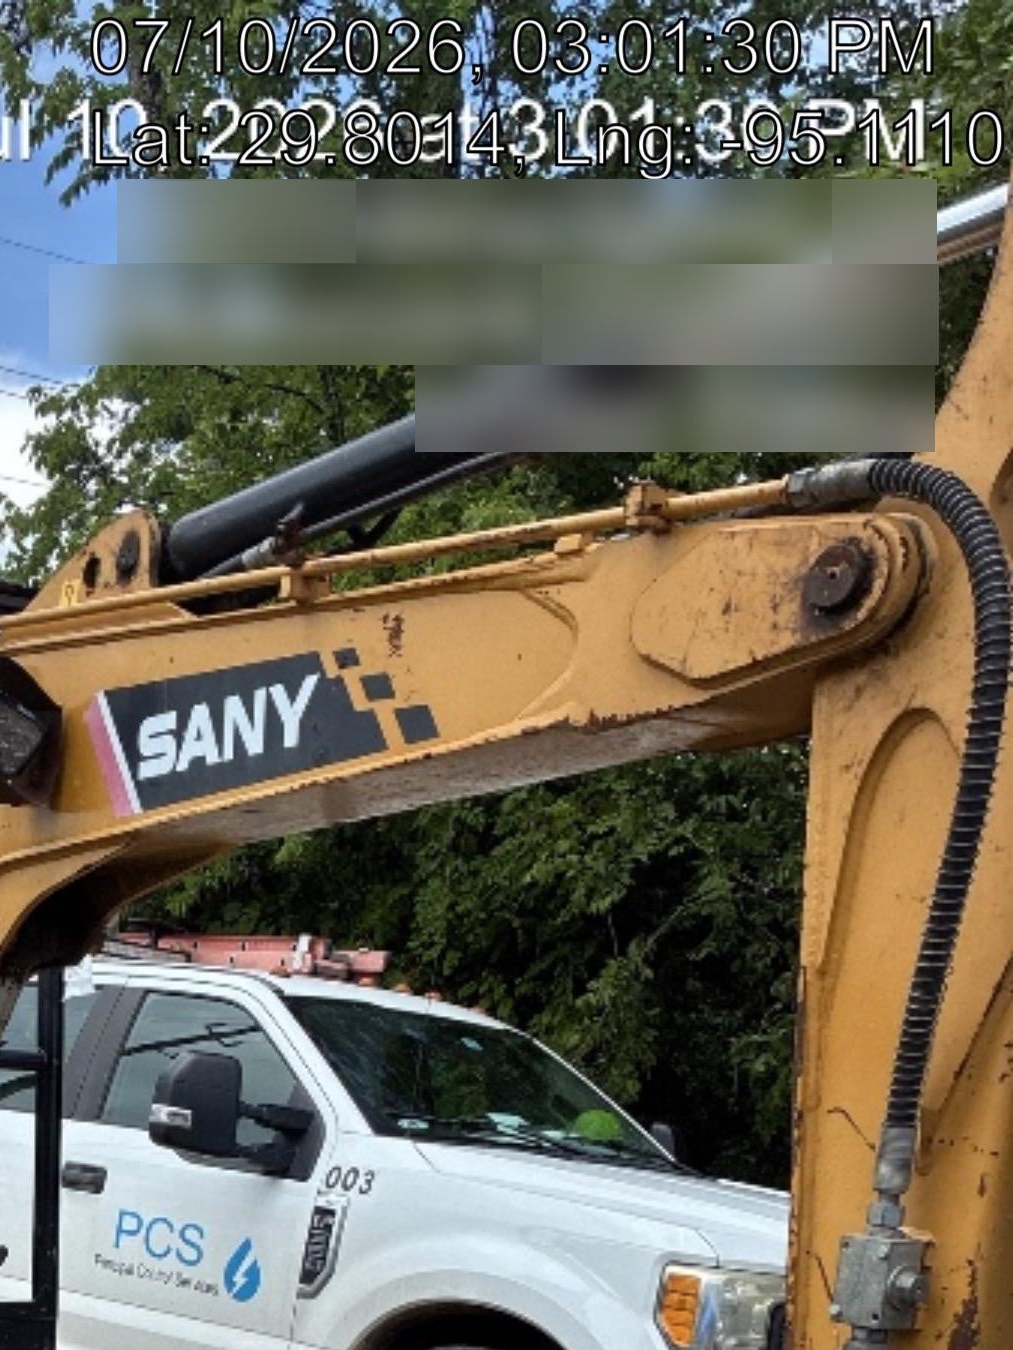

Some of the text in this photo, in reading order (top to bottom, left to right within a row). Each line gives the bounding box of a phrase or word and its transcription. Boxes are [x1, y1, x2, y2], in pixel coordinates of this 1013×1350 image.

[137, 671, 321, 781] SANY
[325, 1165, 376, 1195] 003
[113, 1208, 205, 1267] PCS
